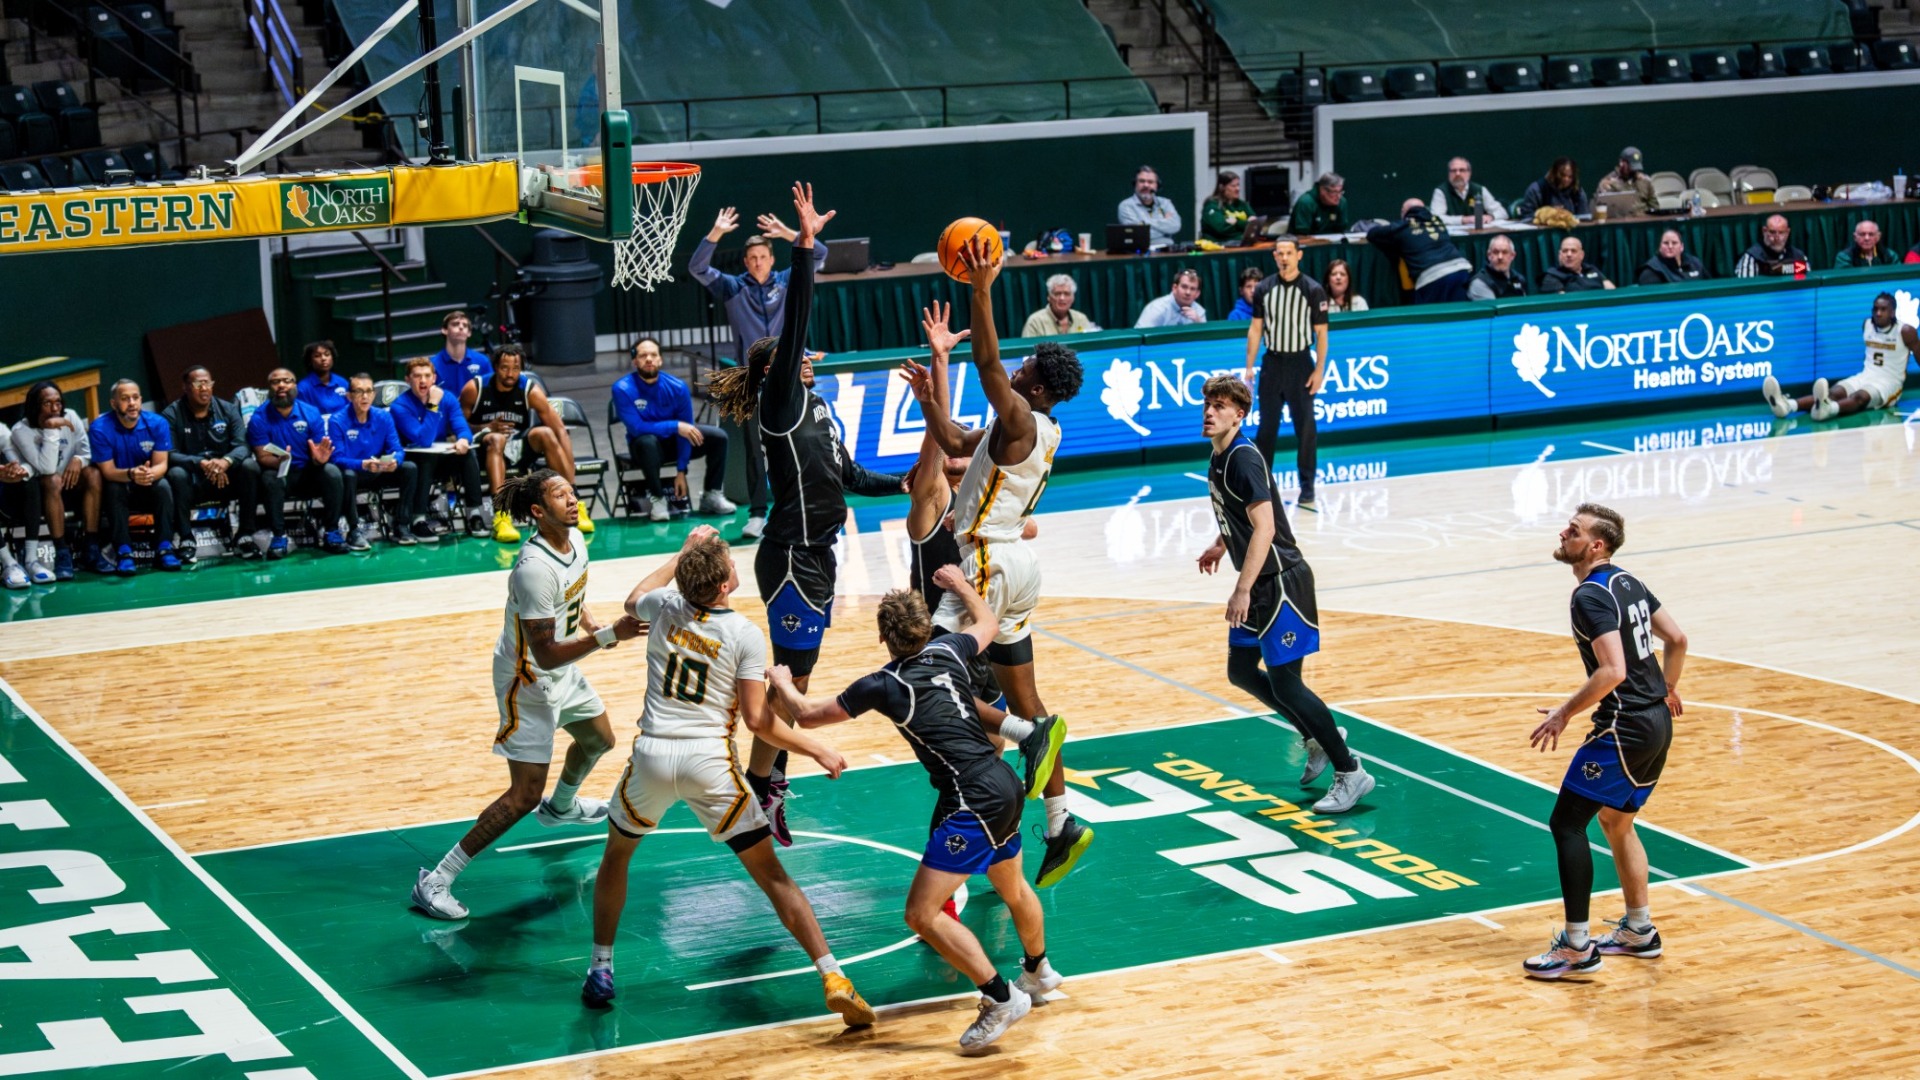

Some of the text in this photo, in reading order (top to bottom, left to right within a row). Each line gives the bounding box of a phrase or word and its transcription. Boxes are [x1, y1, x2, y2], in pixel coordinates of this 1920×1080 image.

[310, 183, 384, 208] NORTH
[319, 202, 376, 225] OAKS
[1634, 361, 1773, 390] Health System
[565, 592, 586, 637] 2
[1628, 599, 1655, 660] 22
[666, 624, 722, 660] LAWRENCE
[663, 651, 710, 704] 10
[1153, 759, 1480, 891] SOUTHLAND
